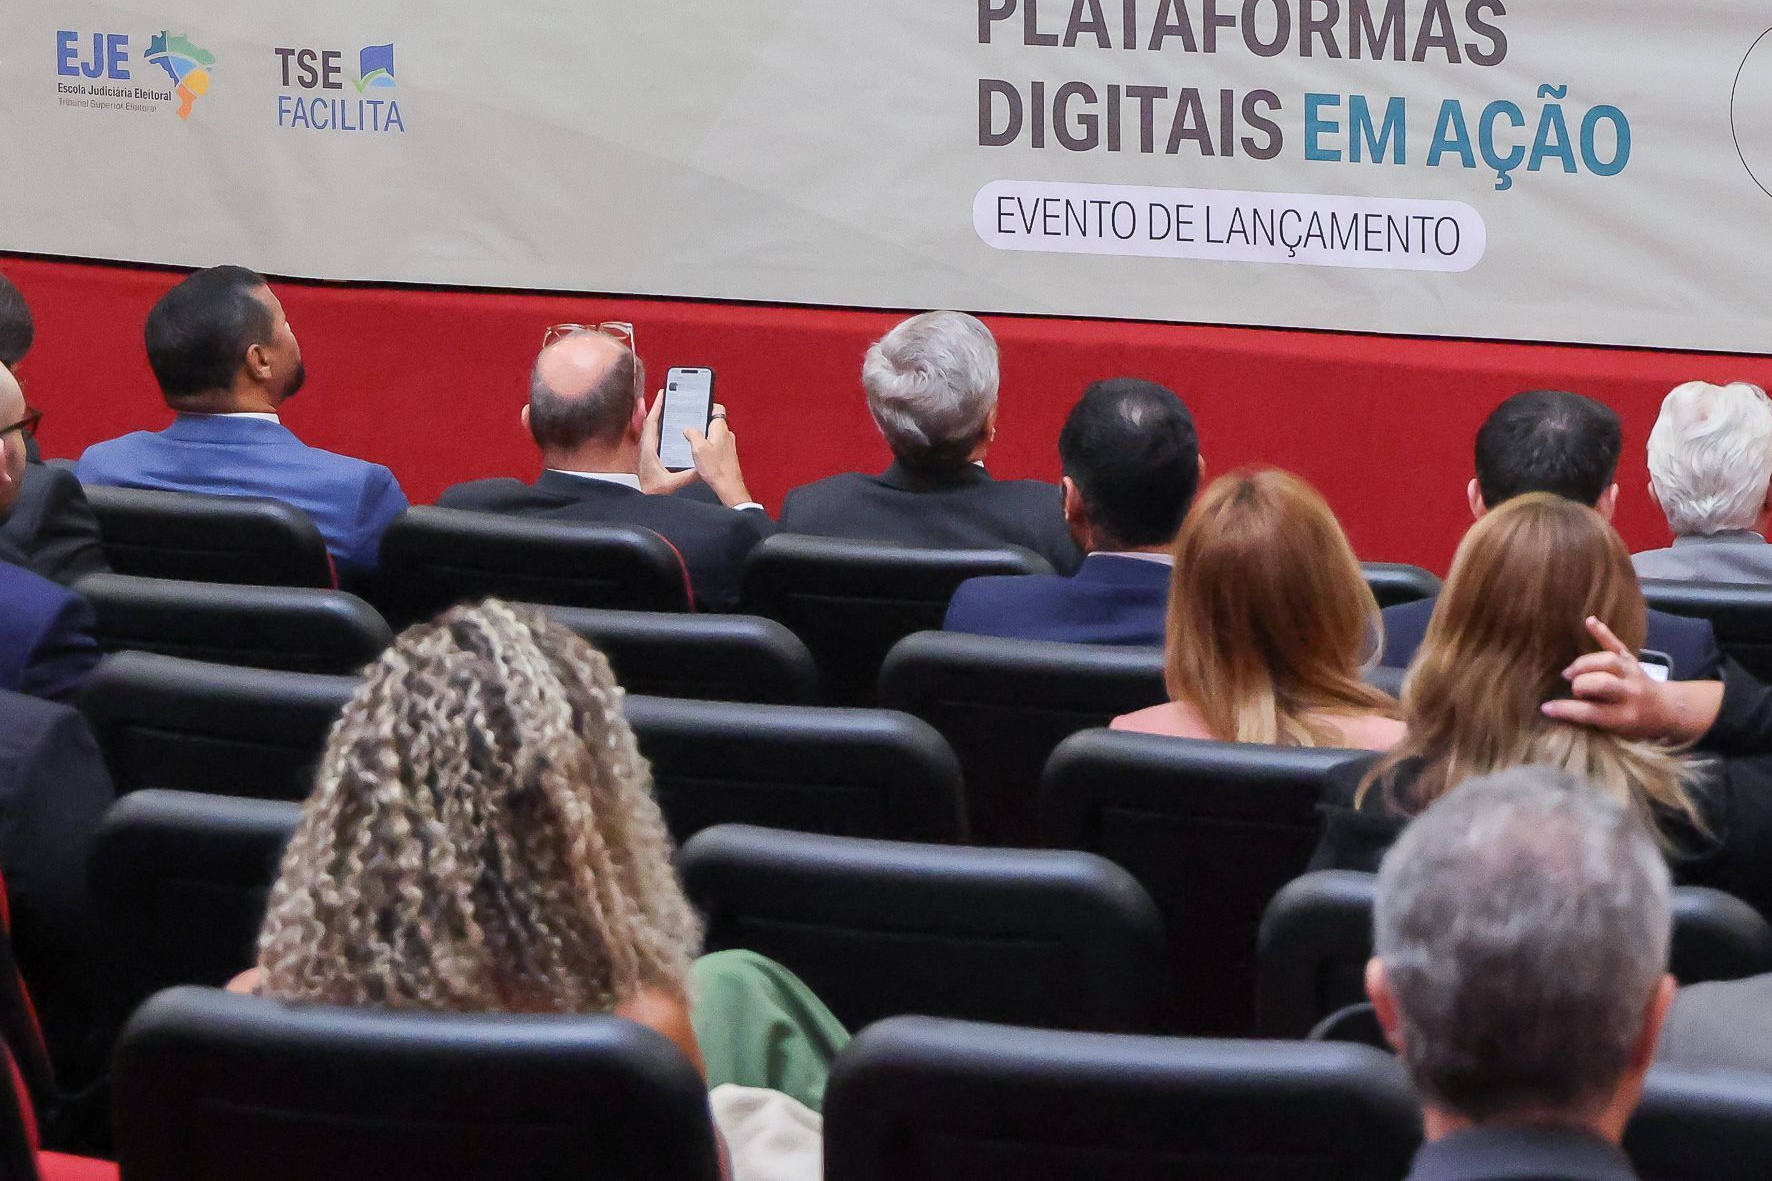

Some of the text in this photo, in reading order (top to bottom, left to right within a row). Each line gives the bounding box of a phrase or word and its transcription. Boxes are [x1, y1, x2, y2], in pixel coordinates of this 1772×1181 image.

[56, 30, 131, 79] EJE
[275, 48, 342, 89] TSE
[58, 83, 172, 101] Escola Judiciária Eleitoral
[58, 98, 88, 107] Tribunal
[90, 100, 123, 110] Superior
[279, 96, 404, 131] FACILITA
[977, 78, 1630, 190] DIGITAIS EM AÇÃO
[997, 196, 1460, 258] EVENTO DE LANÇAMENTO
